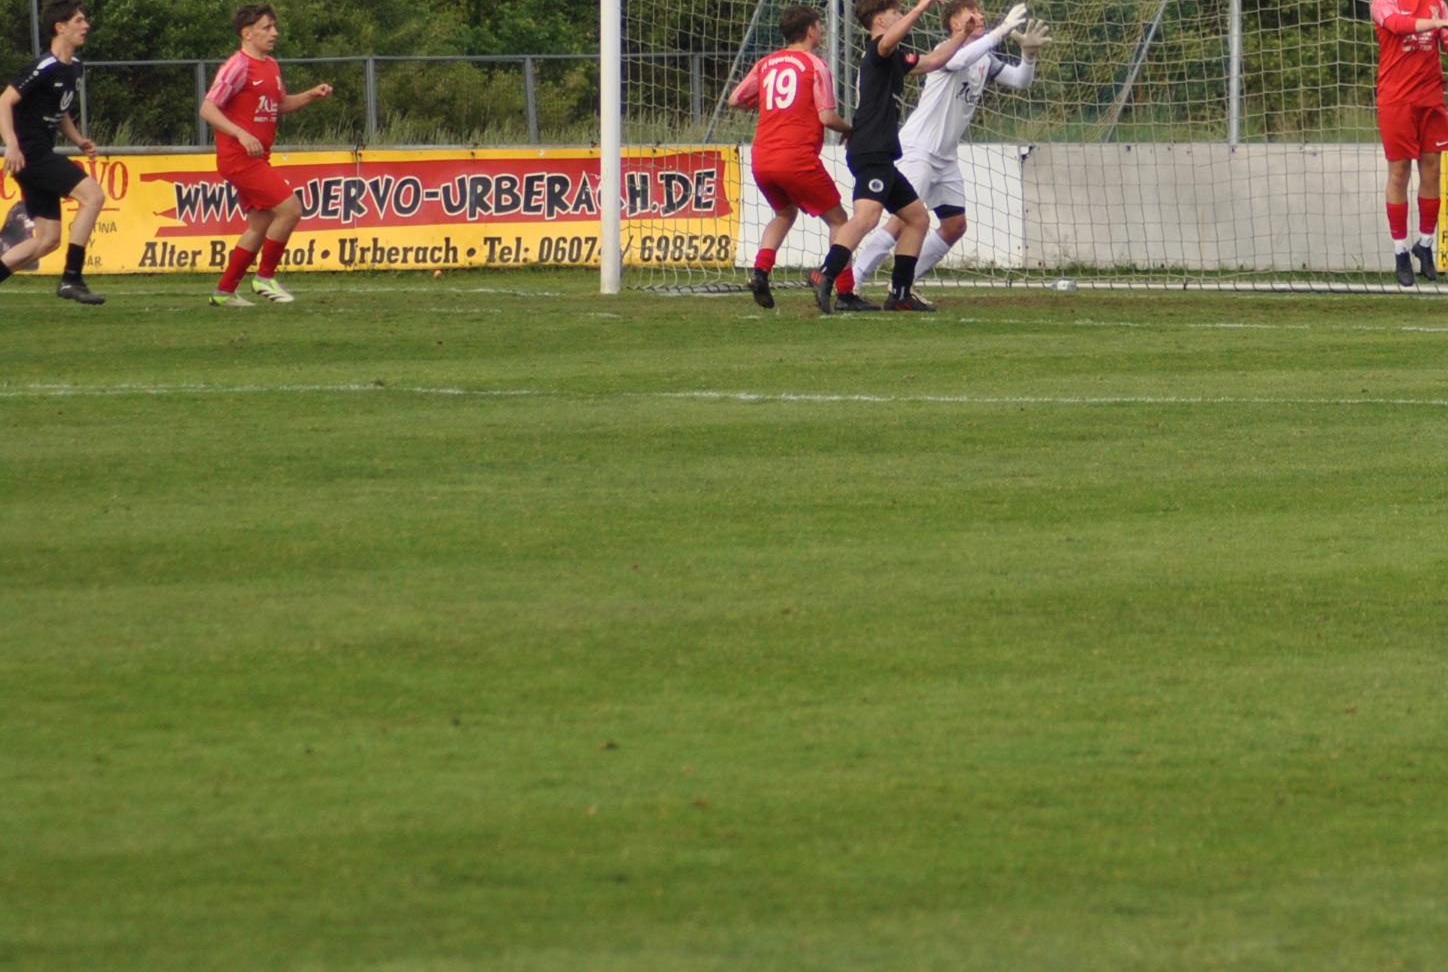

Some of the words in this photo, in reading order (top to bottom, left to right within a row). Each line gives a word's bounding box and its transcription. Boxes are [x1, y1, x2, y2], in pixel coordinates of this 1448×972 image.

[762, 68, 798, 111] 19
[83, 255, 103, 267] AR
[138, 241, 203, 268] Alter
[338, 236, 460, 265] Urberach
[483, 236, 530, 264] Tel:
[537, 235, 603, 263] 0607
[640, 234, 730, 263] 698528
